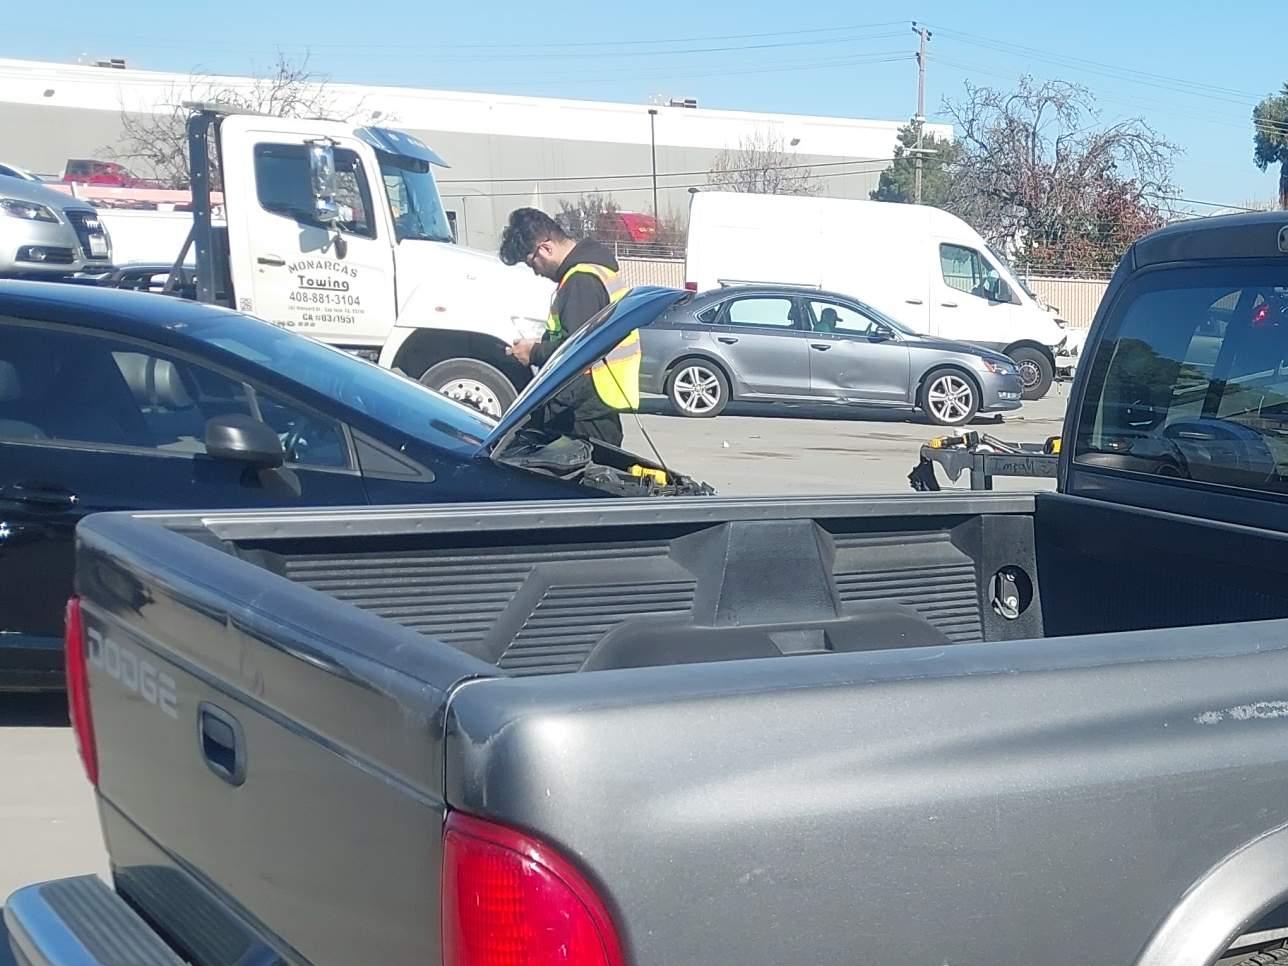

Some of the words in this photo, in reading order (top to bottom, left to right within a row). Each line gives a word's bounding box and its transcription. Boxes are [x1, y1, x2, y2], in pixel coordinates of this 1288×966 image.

[288, 260, 358, 278] MONARCAS
[297, 275, 350, 291] Towing
[289, 291, 361, 305] 408-881-3104
[302, 313, 313, 321] CA
[88, 626, 178, 719] DODGE
